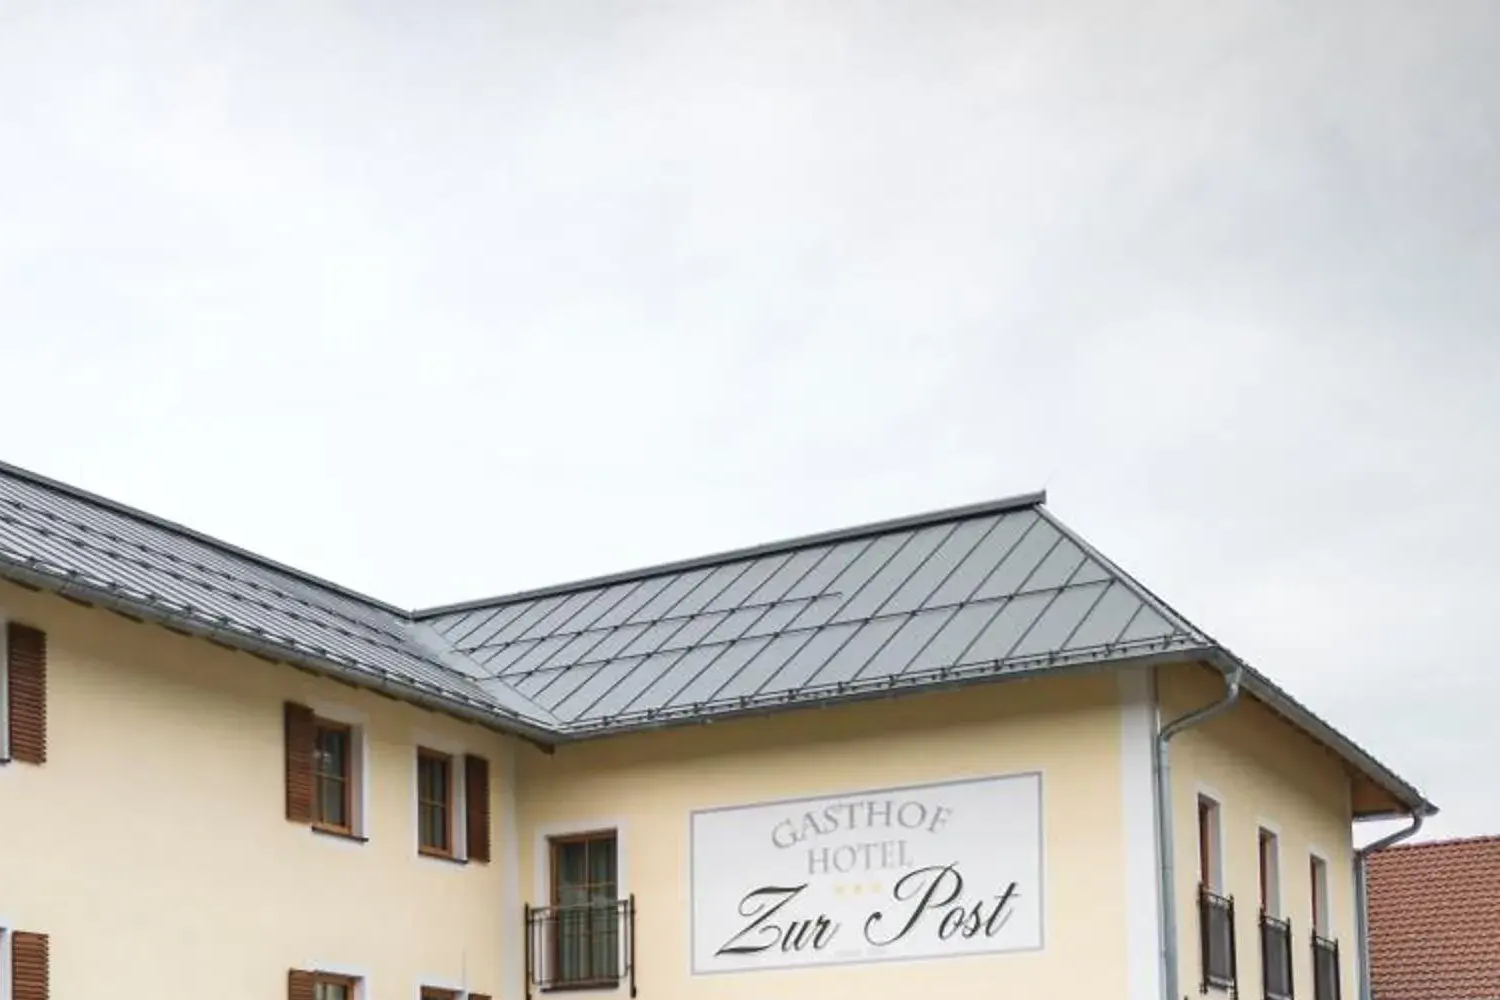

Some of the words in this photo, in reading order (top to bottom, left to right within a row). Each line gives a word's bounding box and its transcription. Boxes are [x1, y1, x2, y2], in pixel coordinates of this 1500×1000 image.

[771, 798, 954, 849] GASTHOF
[807, 840, 914, 875] HOTEL
[713, 883, 841, 957] Zur
[864, 860, 1019, 947] Post
